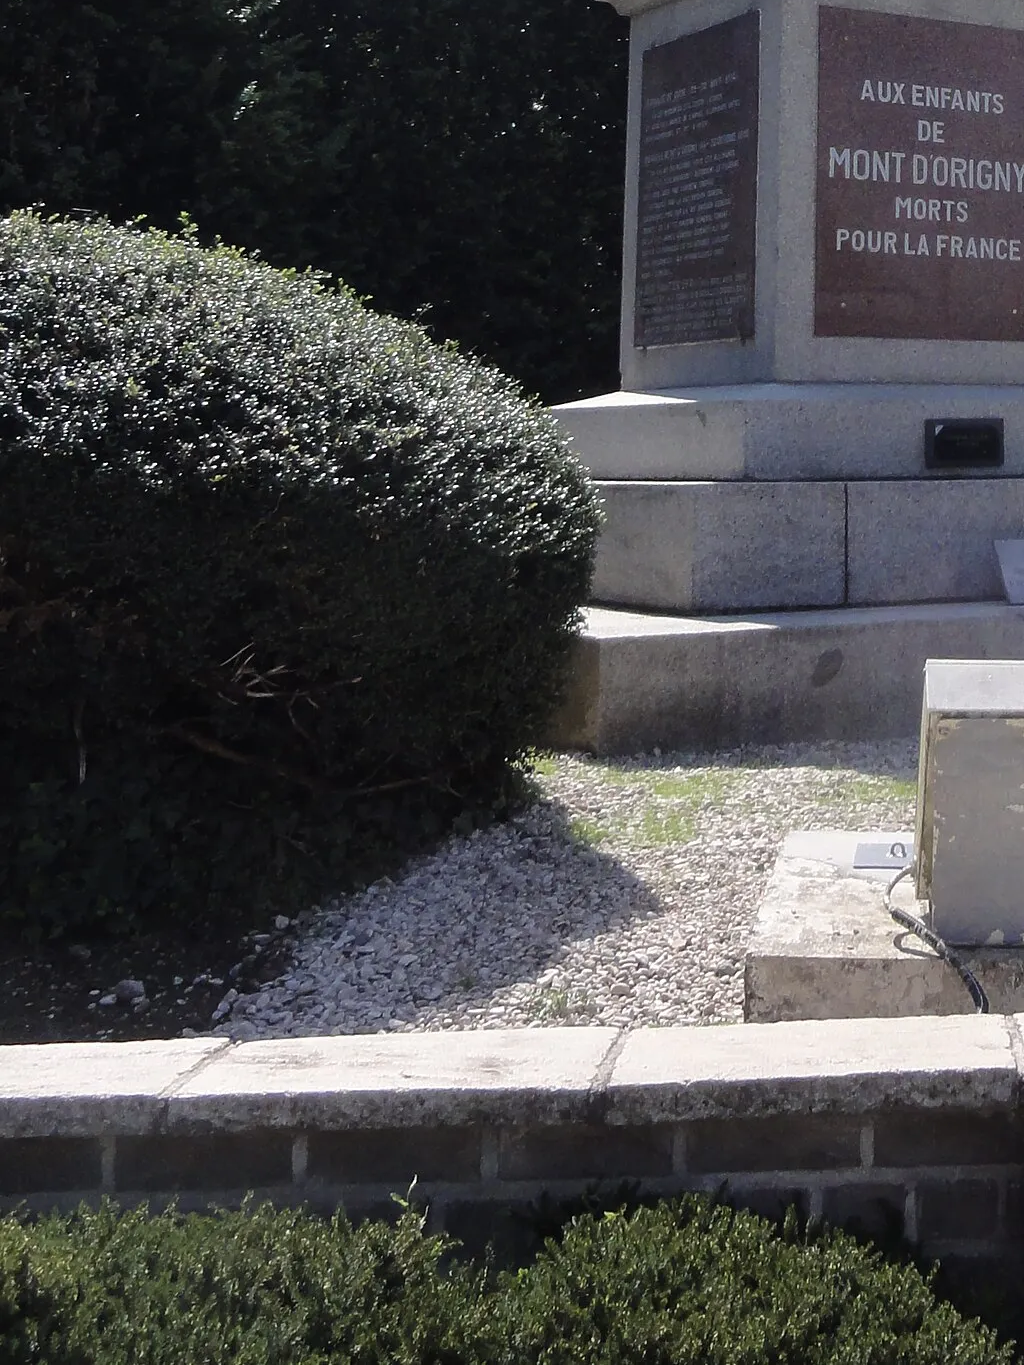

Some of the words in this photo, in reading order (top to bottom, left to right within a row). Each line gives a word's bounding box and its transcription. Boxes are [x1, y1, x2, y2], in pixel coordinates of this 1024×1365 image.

[861, 80, 905, 105] AUX
[911, 84, 1004, 114] ENFANTS
[918, 120, 945, 143] DE
[828, 146, 906, 183] MONT
[895, 196, 969, 222] MORTS
[836, 228, 897, 254] POUR
[904, 233, 929, 257] LA
[936, 234, 1021, 261] FRANCE
